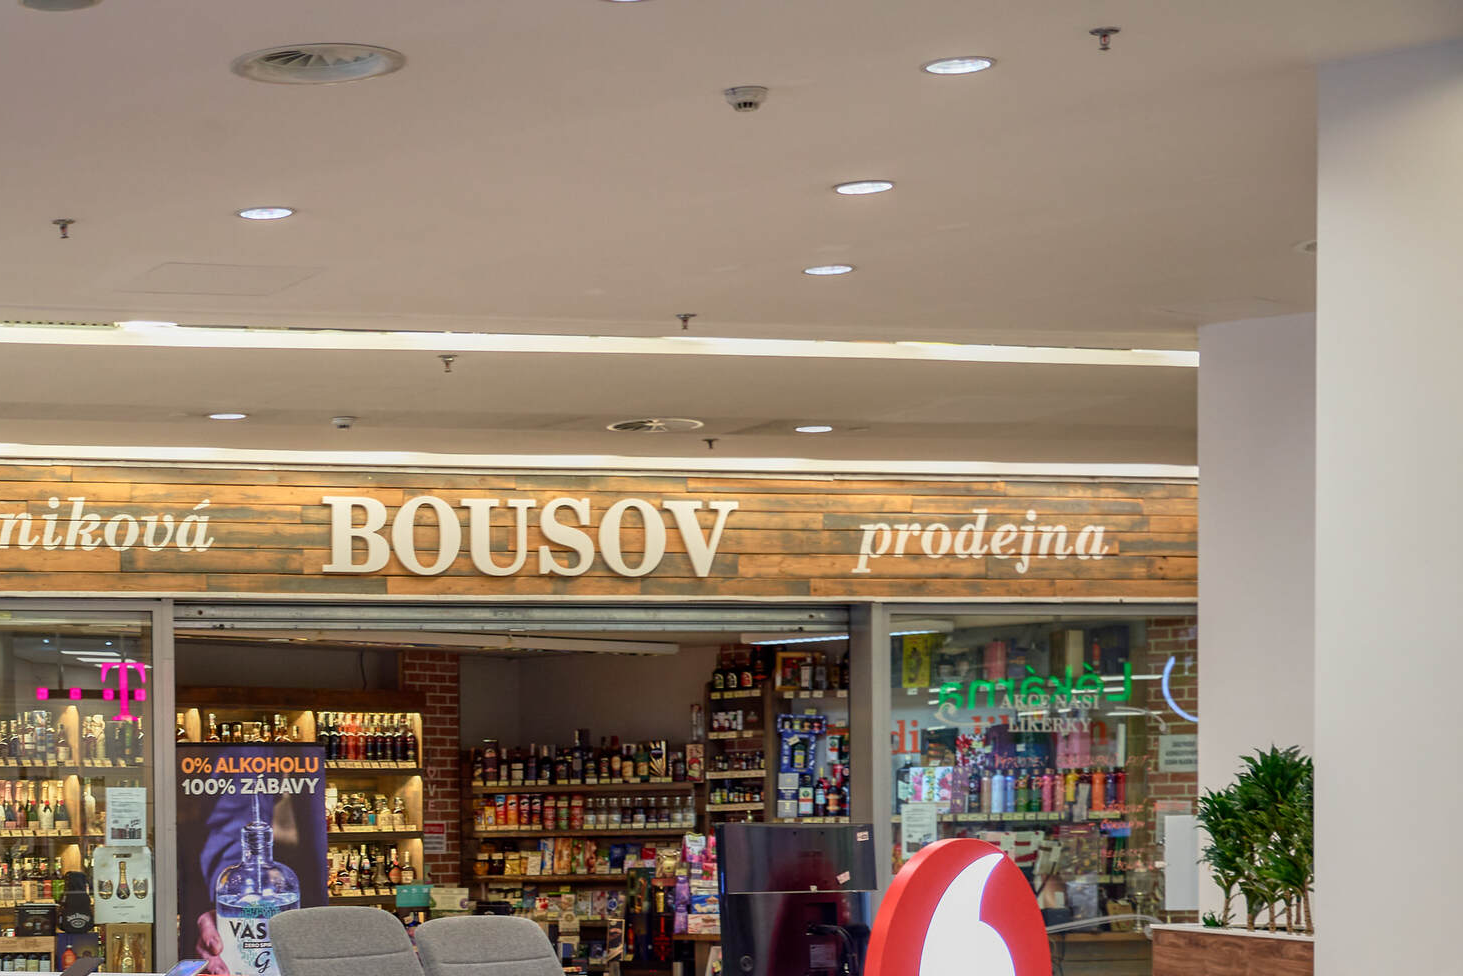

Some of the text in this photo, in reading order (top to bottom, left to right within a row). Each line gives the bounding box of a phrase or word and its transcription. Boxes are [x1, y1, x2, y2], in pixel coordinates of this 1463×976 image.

[322, 495, 739, 578] BOUSOV
[852, 508, 1110, 574] prodejna
[181, 756, 319, 774] 0% ALKOHOLU
[181, 773, 320, 795] 100% ZÁBAVY
